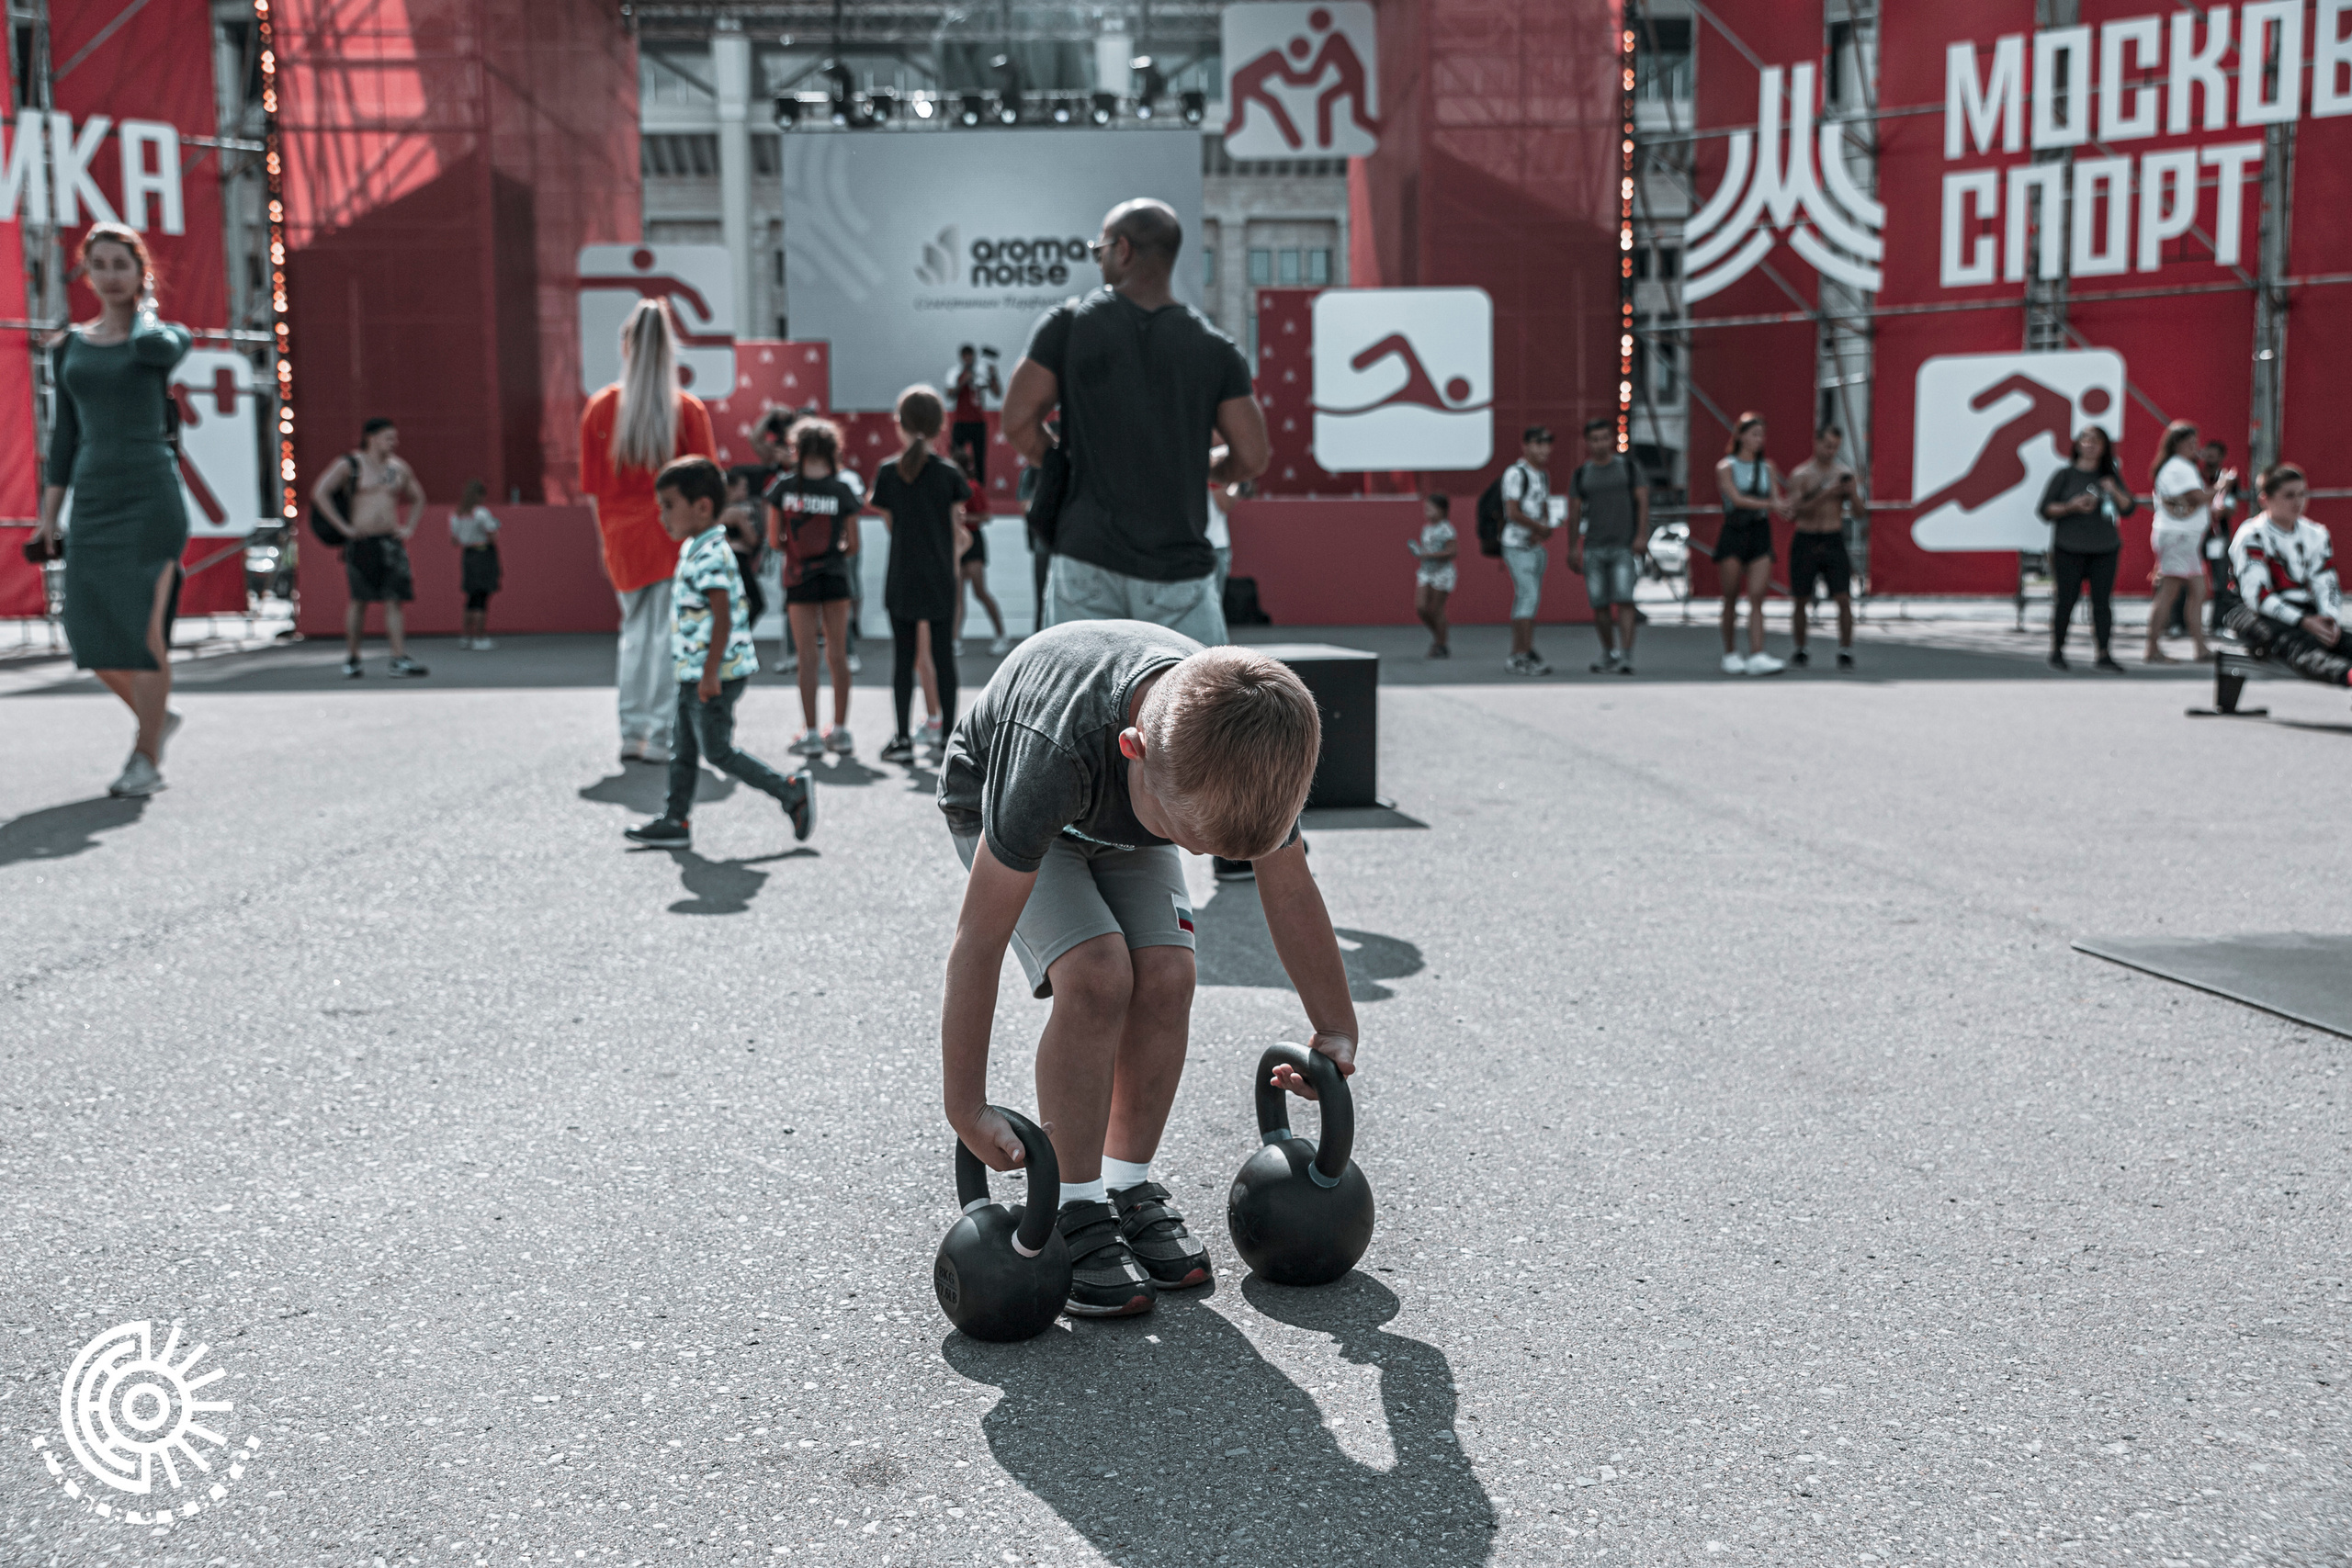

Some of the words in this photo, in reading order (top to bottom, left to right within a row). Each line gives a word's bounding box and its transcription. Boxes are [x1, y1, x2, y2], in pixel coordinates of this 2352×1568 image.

[1939, 139, 2266, 288] СПОРТ
[971, 238, 1088, 263] aroma
[971, 264, 1069, 288] noise
[939, 1266, 955, 1284] 8KG
